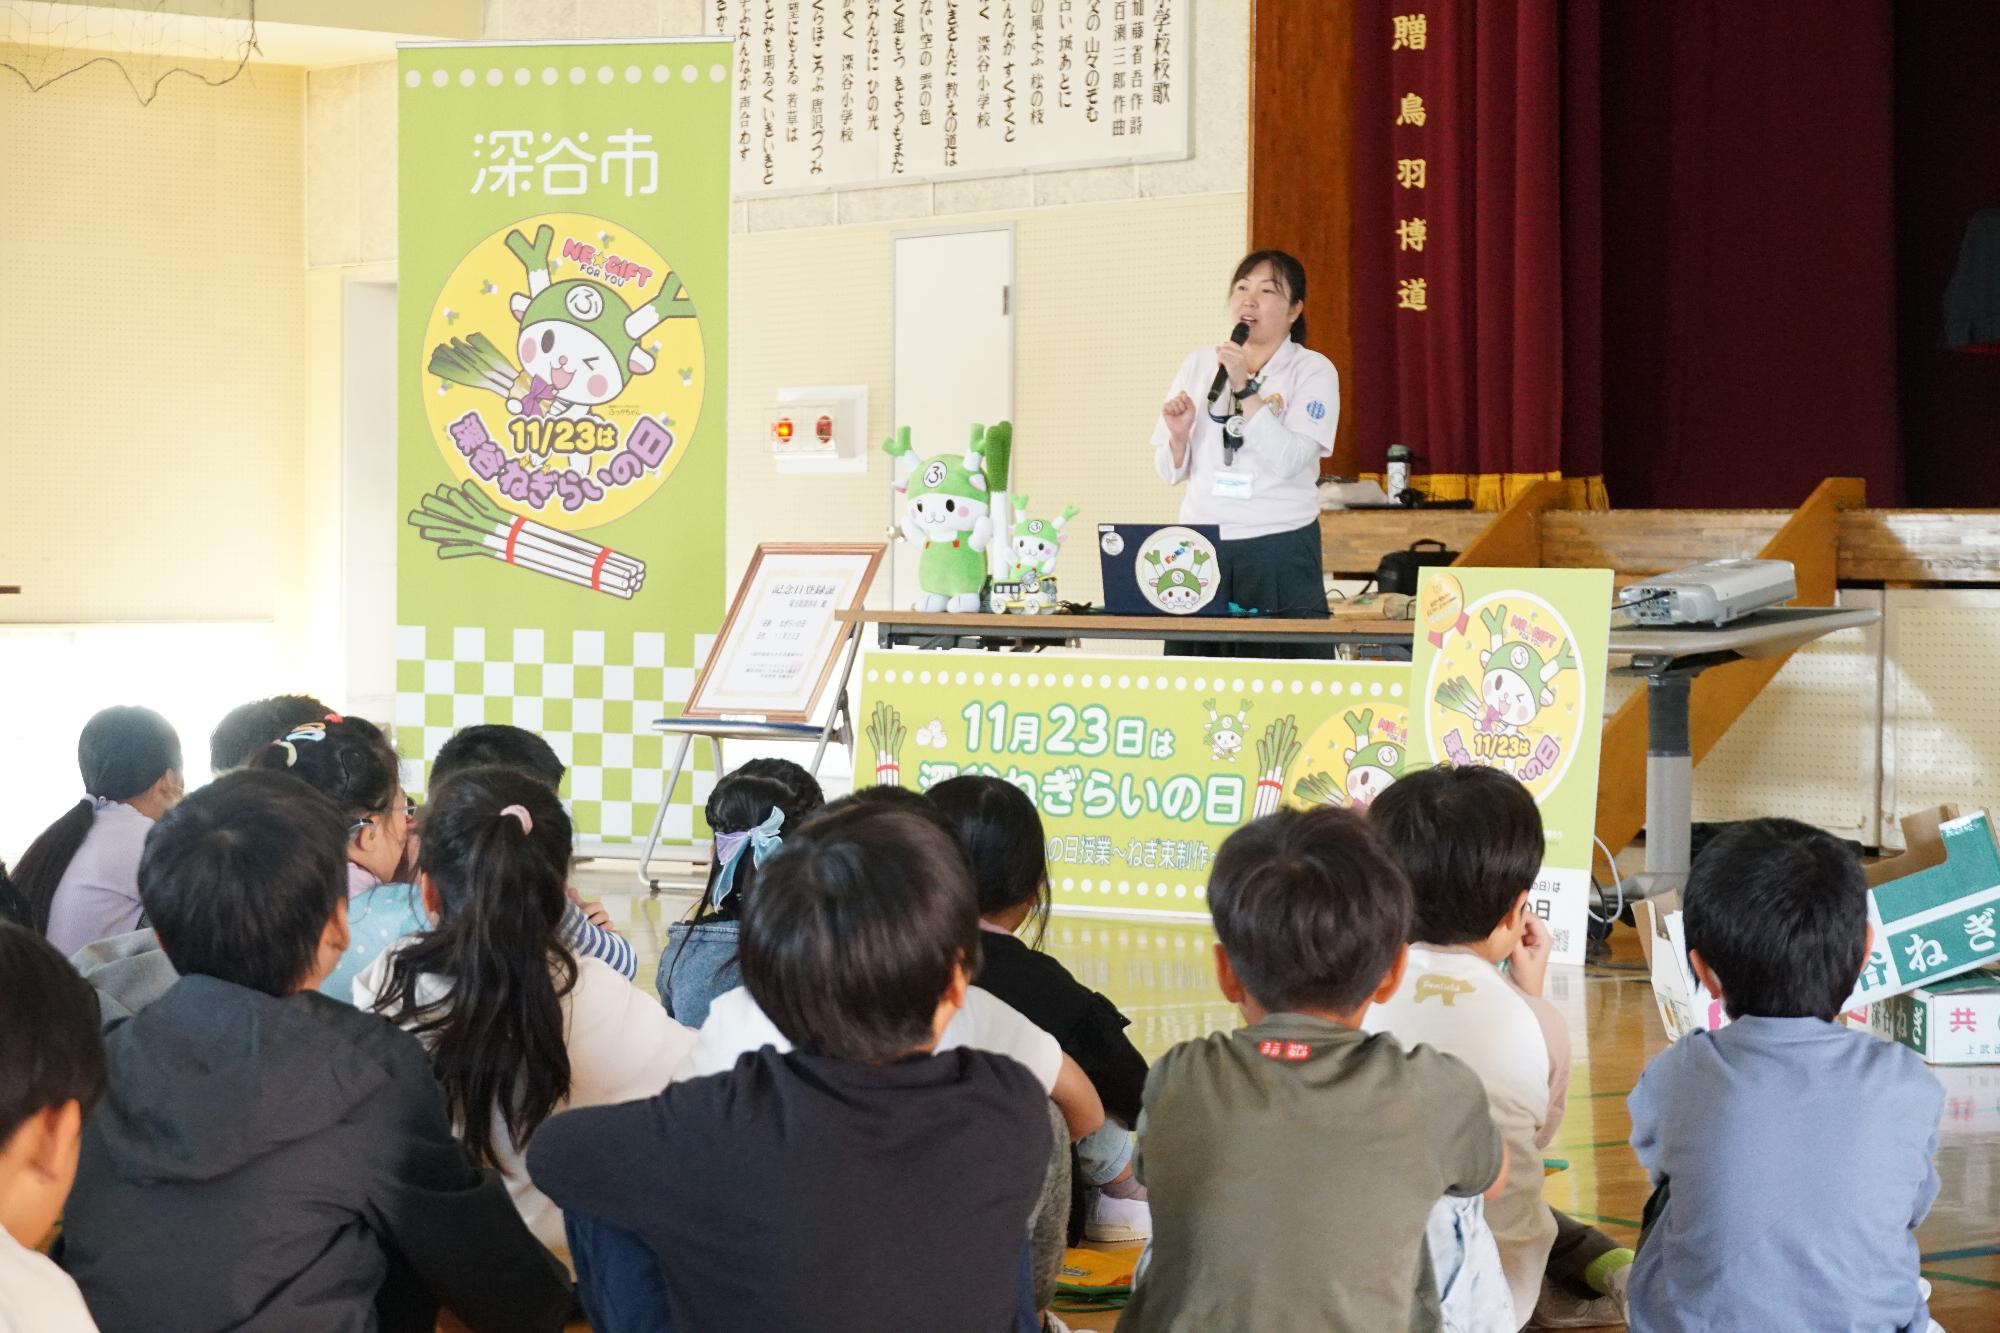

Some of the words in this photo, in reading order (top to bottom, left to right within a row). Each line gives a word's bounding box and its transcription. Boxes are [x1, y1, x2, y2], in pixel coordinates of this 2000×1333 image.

[764, 0, 776, 102] とみも明るく
[868, 0, 880, 71] みんなに
[894, 0, 906, 66] く進もう
[1004, 0, 1016, 55] んなが
[1392, 14, 1427, 50] 贈
[842, 55, 854, 141] 深谷小学校
[978, 35, 991, 128] 深谷小学校
[1004, 62, 1017, 142] すくすくと
[764, 108, 775, 185] いきいきと
[946, 82, 959, 166] 教えの道は
[471, 127, 658, 198] 深谷市
[1396, 93, 1427, 311] 鳥羽博道
[580, 264, 600, 277] FOR
[605, 272, 624, 287] YOU
[450, 412, 673, 511] 深谷ねぎらいの日
[508, 418, 618, 456] 11/23は
[962, 700, 1174, 759] 11月23日は
[1045, 836, 1216, 871] の日授業〜ねぎ束制作
[1905, 907, 1996, 973] ねぎ
[1950, 1008, 1976, 1033] 共
